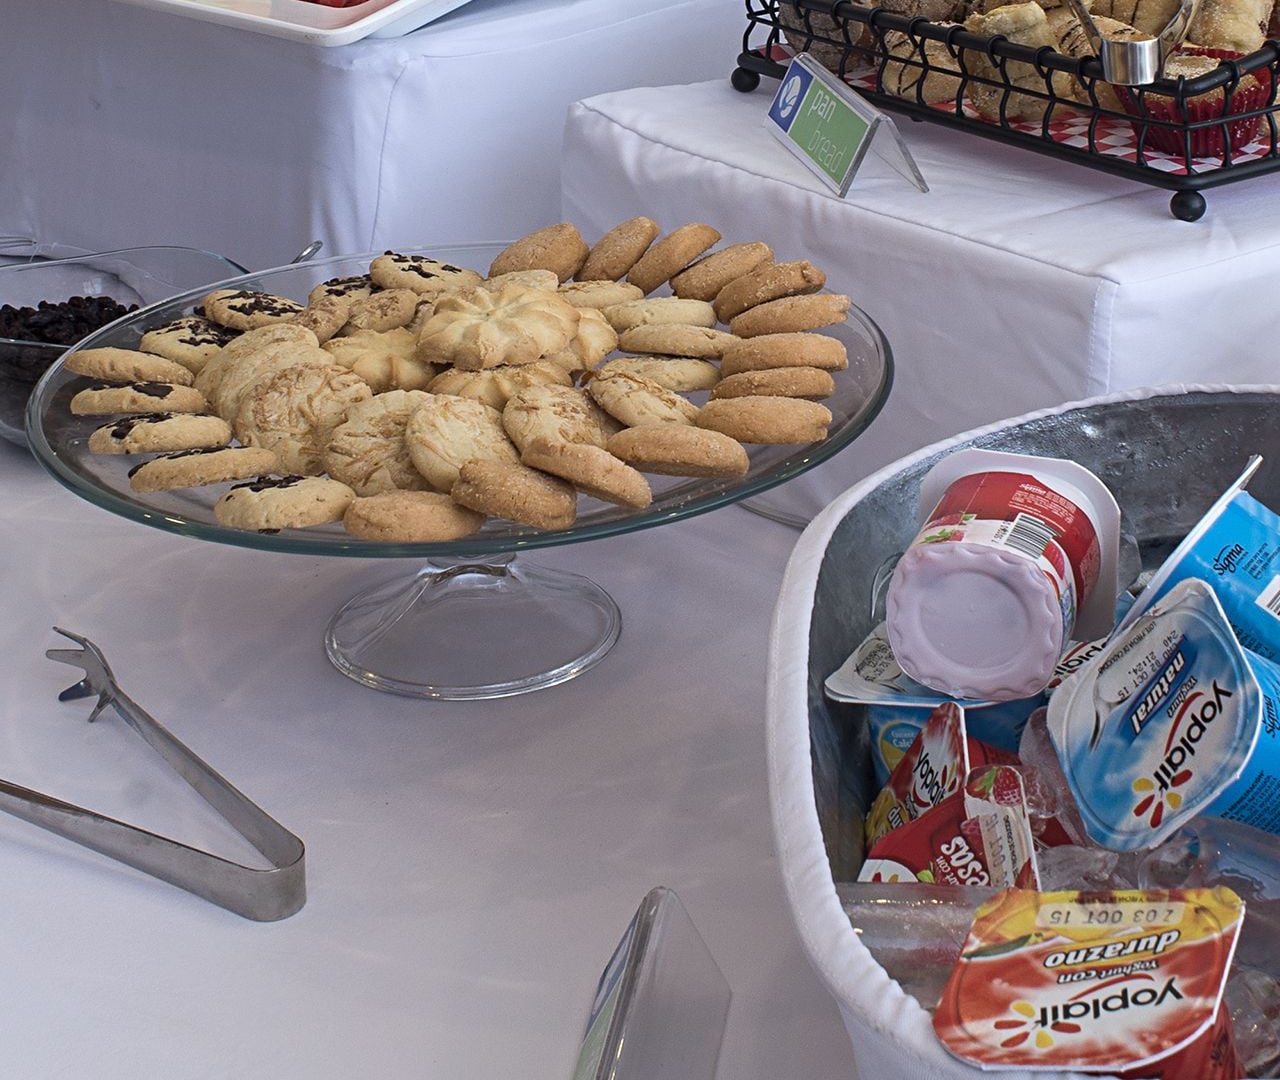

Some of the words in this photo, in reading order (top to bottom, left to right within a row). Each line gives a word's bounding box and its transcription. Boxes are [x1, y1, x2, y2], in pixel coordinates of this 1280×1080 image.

[807, 88, 837, 123] pan
[807, 121, 848, 173] bread
[1054, 640, 1108, 678] plait
[1130, 649, 1185, 735] natural
[1050, 910, 1072, 924] 15
[1085, 910, 1124, 924] OCT
[1132, 909, 1158, 923] 03
[1043, 930, 1180, 968] durazno
[1056, 970, 1098, 984] con
[1098, 960, 1160, 980] Yoghurt
